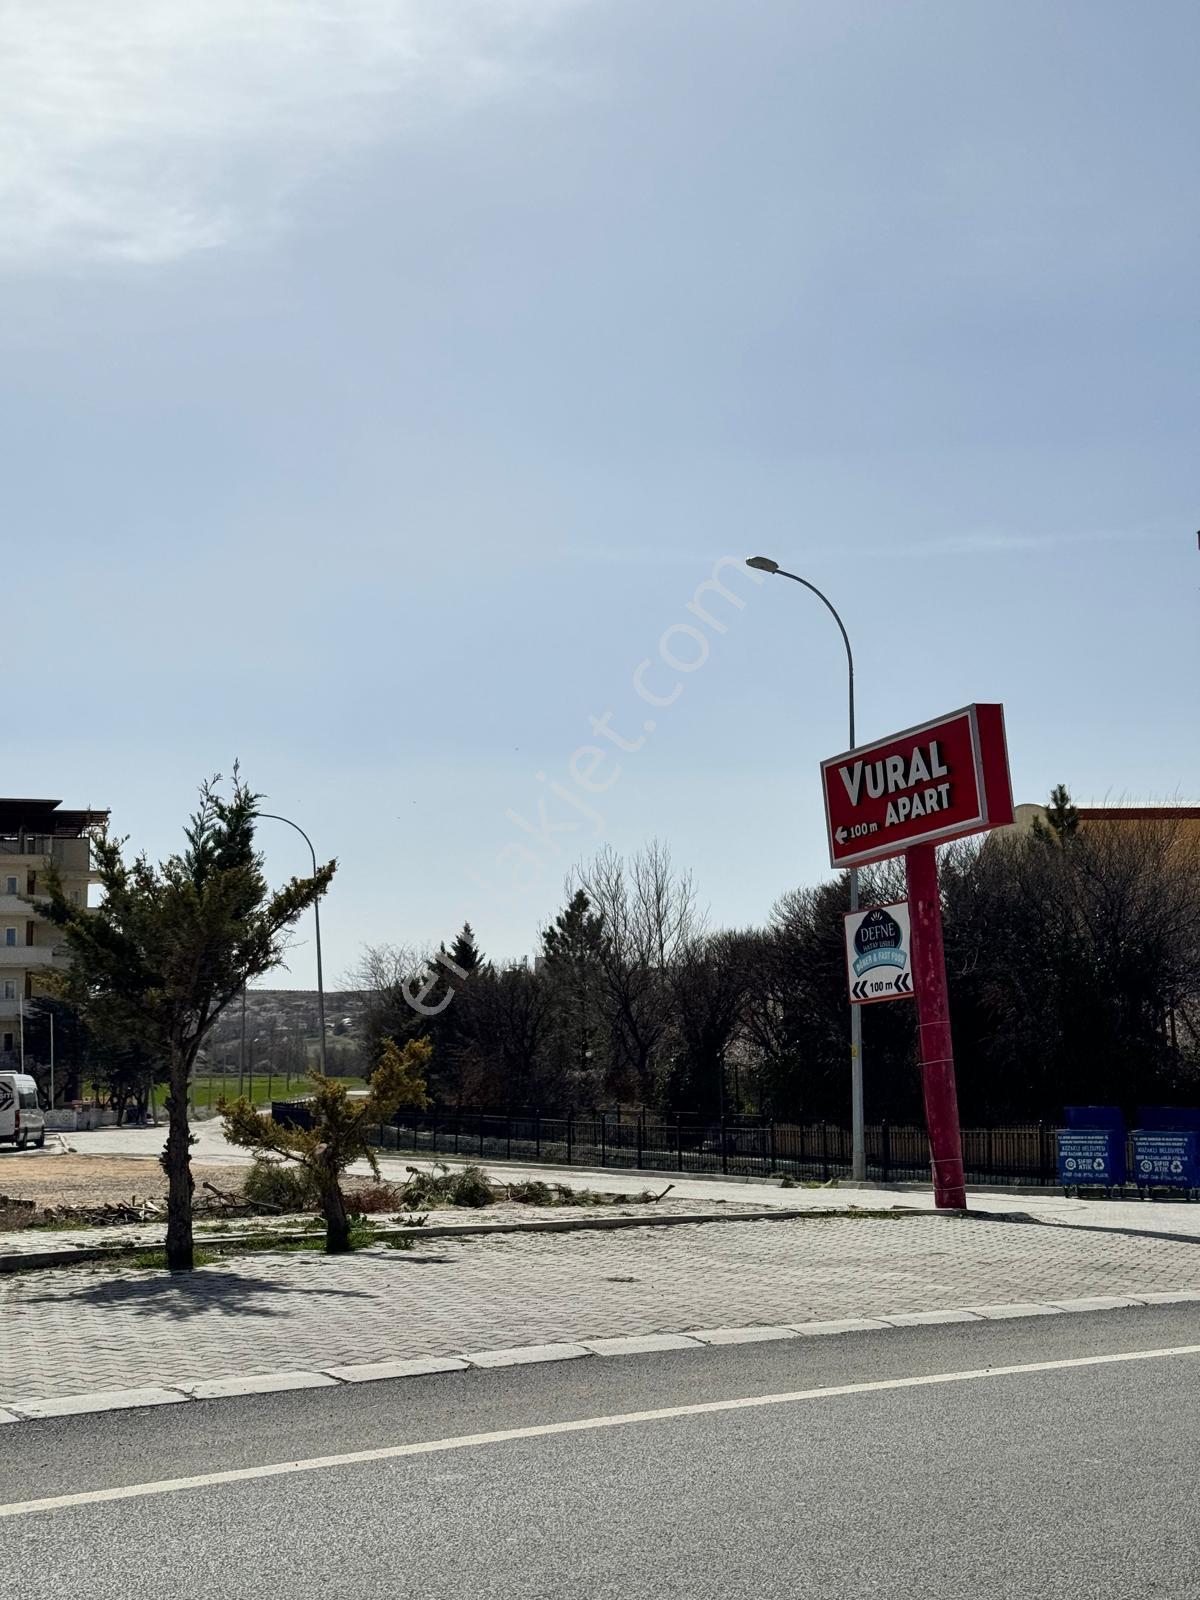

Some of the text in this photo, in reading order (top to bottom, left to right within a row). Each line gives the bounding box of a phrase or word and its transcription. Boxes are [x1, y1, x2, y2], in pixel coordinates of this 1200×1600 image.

[838, 740, 948, 807] VURAL
[885, 782, 950, 827] APART
[850, 821, 878, 839] 100 m
[860, 922, 896, 942] DEFNE
[878, 951, 892, 961] FAST
[870, 981, 893, 993] 100 m
